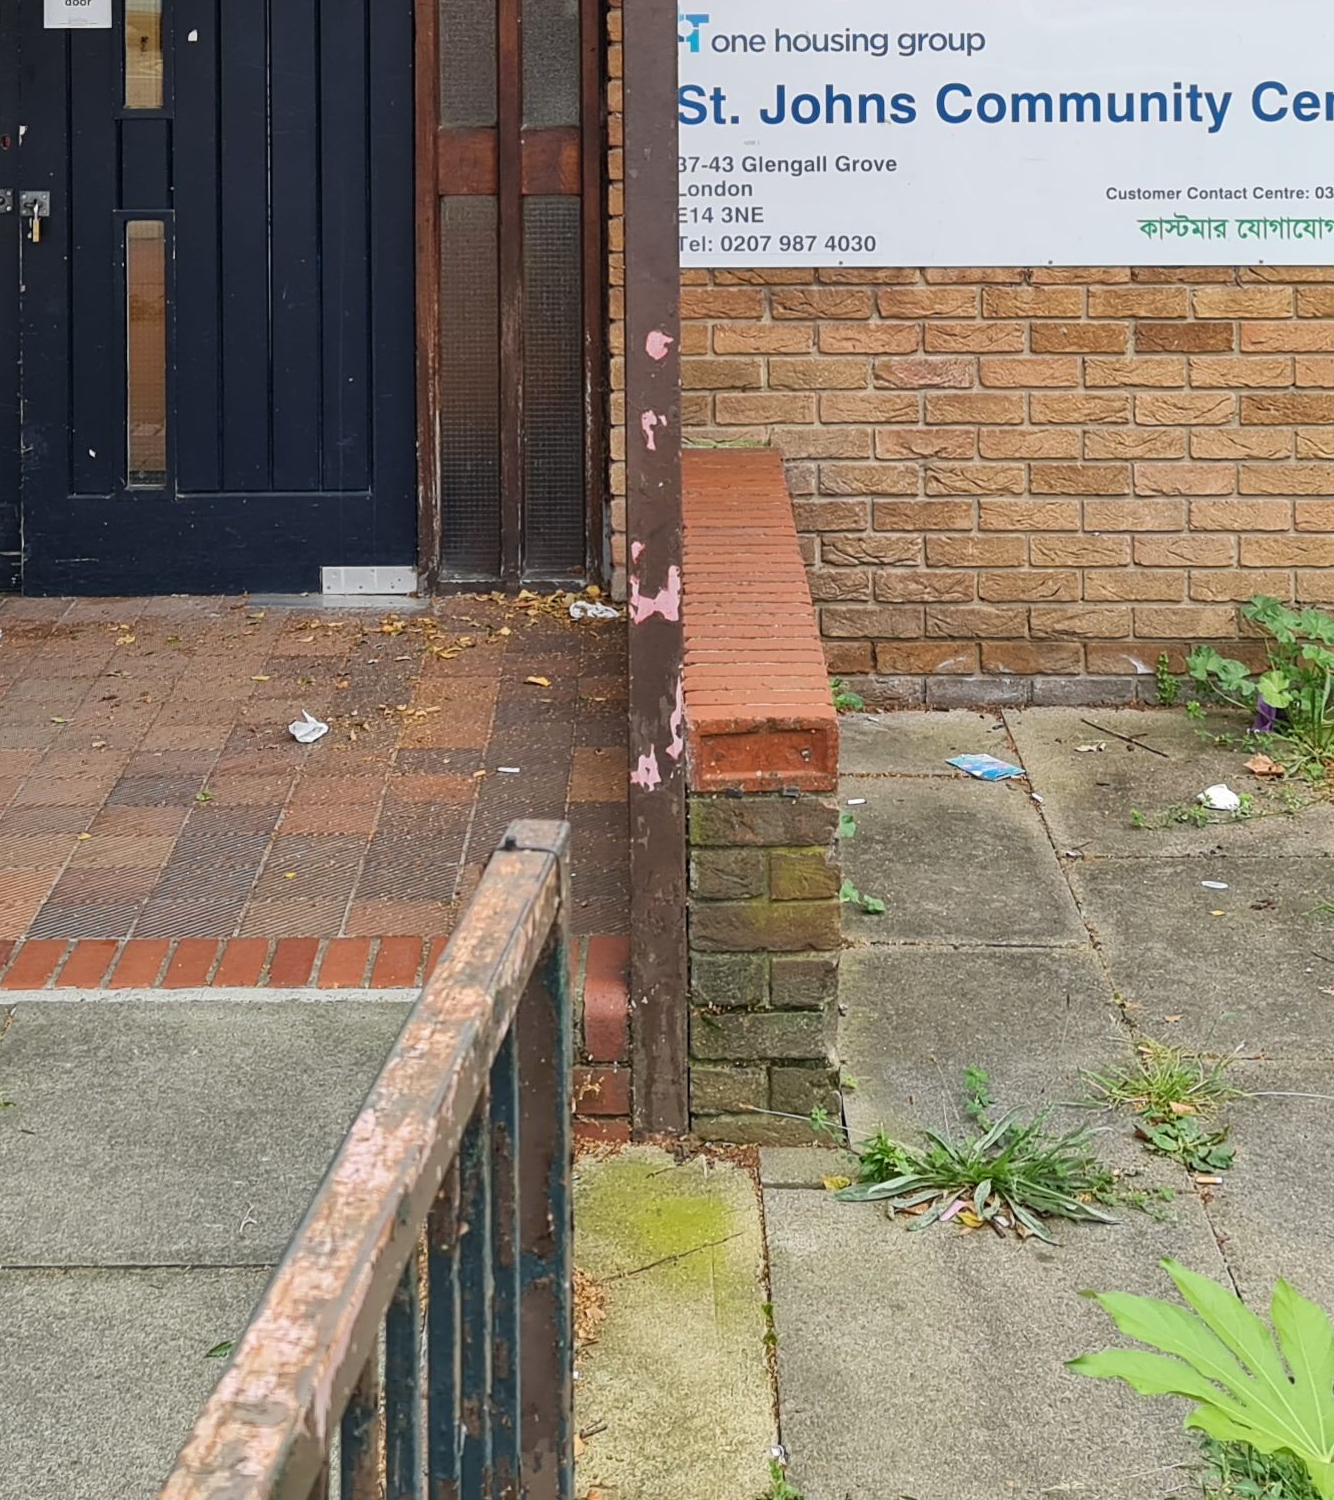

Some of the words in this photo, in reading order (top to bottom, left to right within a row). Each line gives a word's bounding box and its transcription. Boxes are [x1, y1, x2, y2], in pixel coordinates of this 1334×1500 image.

[711, 34, 767, 53] one
[774, 28, 889, 57] housing
[897, 32, 986, 57] group
[678, 84, 740, 126] St.
[759, 84, 917, 125] Johns
[936, 82, 1233, 134] Community
[678, 155, 734, 173] 37-43
[741, 155, 827, 177] Glengall
[835, 155, 898, 173] Grove
[1105, 187, 1182, 200] Customer
[1186, 186, 1248, 200] Contact
[1253, 186, 1310, 200] Centre:
[721, 206, 764, 224] 3NE
[1137, 212, 1229, 240] কাস্টমার
[679, 235, 713, 252] Tel:
[720, 235, 772, 252] 0207
[779, 235, 818, 252] 987
[824, 235, 877, 252] 4030
